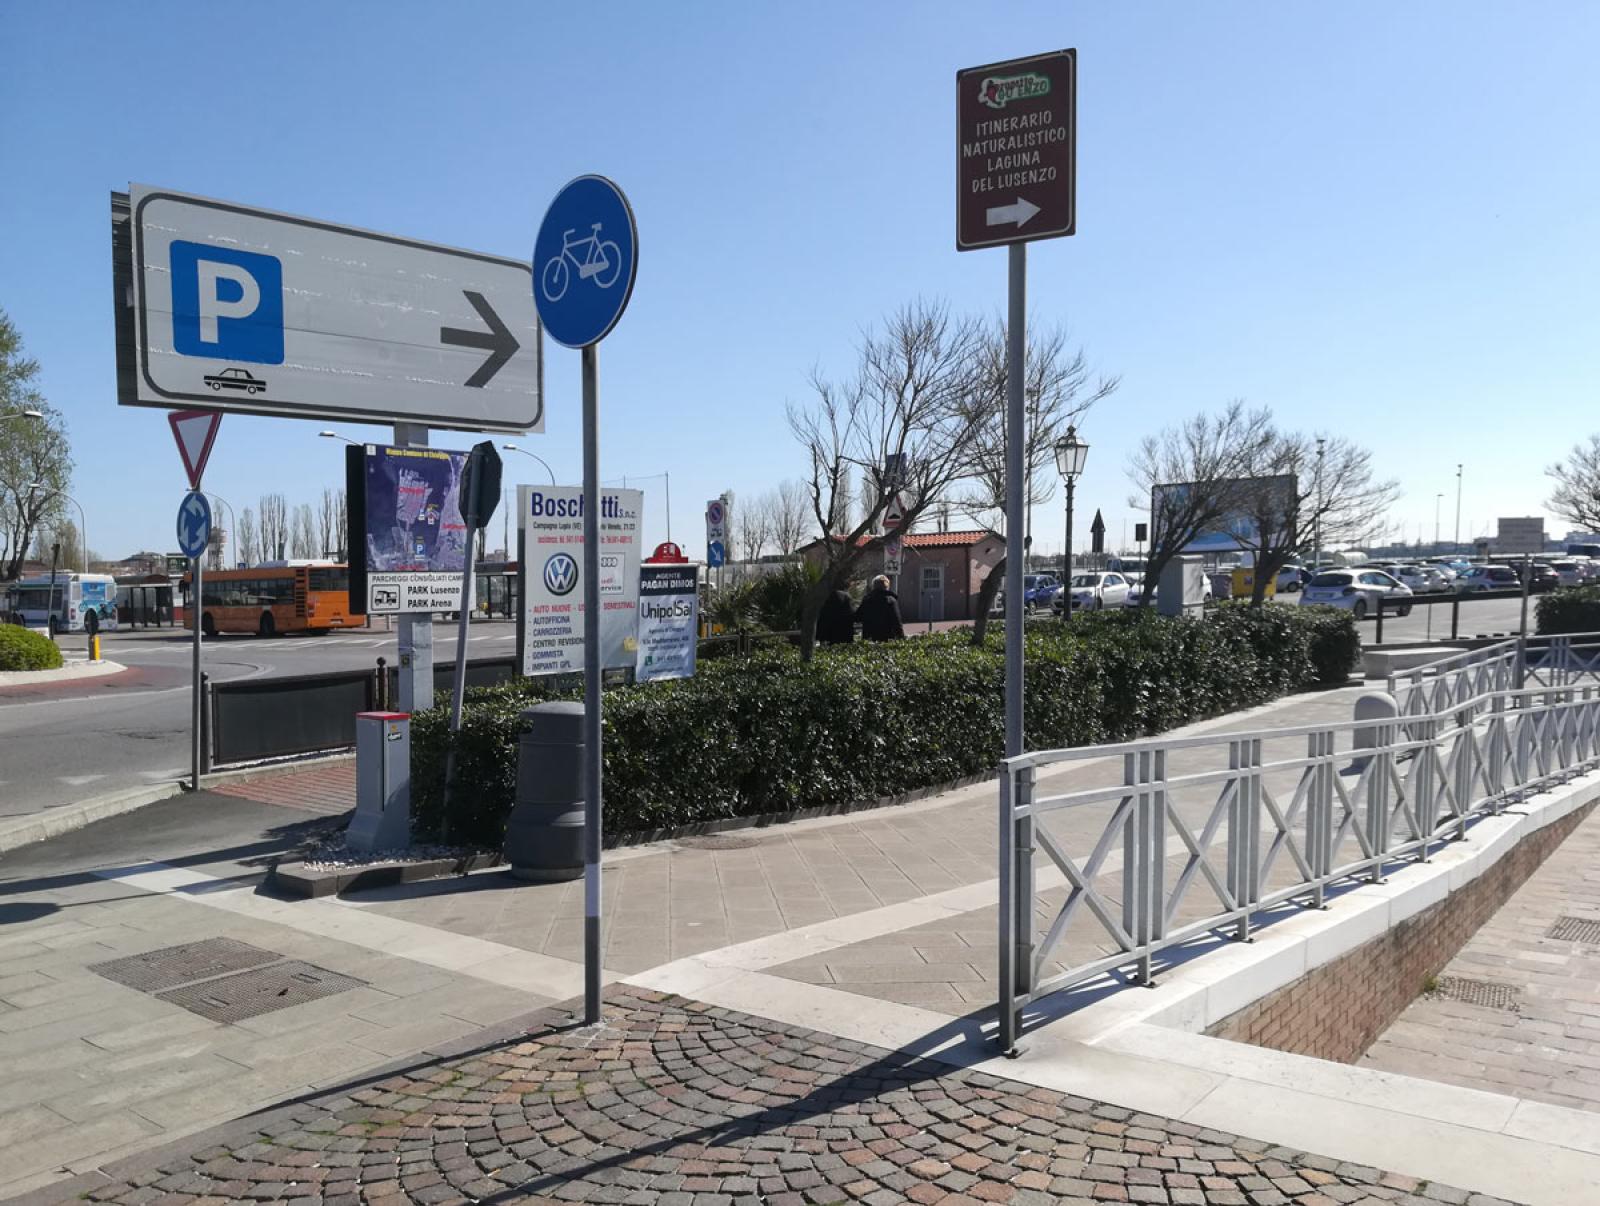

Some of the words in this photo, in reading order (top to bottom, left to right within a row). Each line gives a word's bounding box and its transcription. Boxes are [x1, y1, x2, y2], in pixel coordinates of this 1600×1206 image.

[976, 110, 1052, 138] ITINERARIO
[963, 127, 1066, 158] NATURALISTICO
[987, 150, 1041, 172] LAGUNA
[972, 176, 994, 193] DEL
[998, 166, 1057, 189] LUSENZO
[197, 258, 261, 344] P
[531, 492, 618, 518] Bosctti
[372, 575, 409, 583] PARCHEGGI
[656, 571, 682, 580] AGENTE
[640, 580, 669, 589] PAGAN
[407, 586, 428, 595] PARK
[430, 586, 461, 595] Lusenzo
[407, 600, 428, 608] PARK
[430, 600, 452, 608] Arena
[533, 605, 550, 614] AUTO
[533, 615, 571, 625] AUTOFFICINA
[533, 627, 573, 637] CARROZZERIA
[532, 639, 557, 648] CENTRO
[558, 637, 584, 646] REVISION
[532, 650, 564, 660] GOMMISTA
[531, 661, 559, 671] IMPIANTI
[559, 661, 571, 669] GPL
